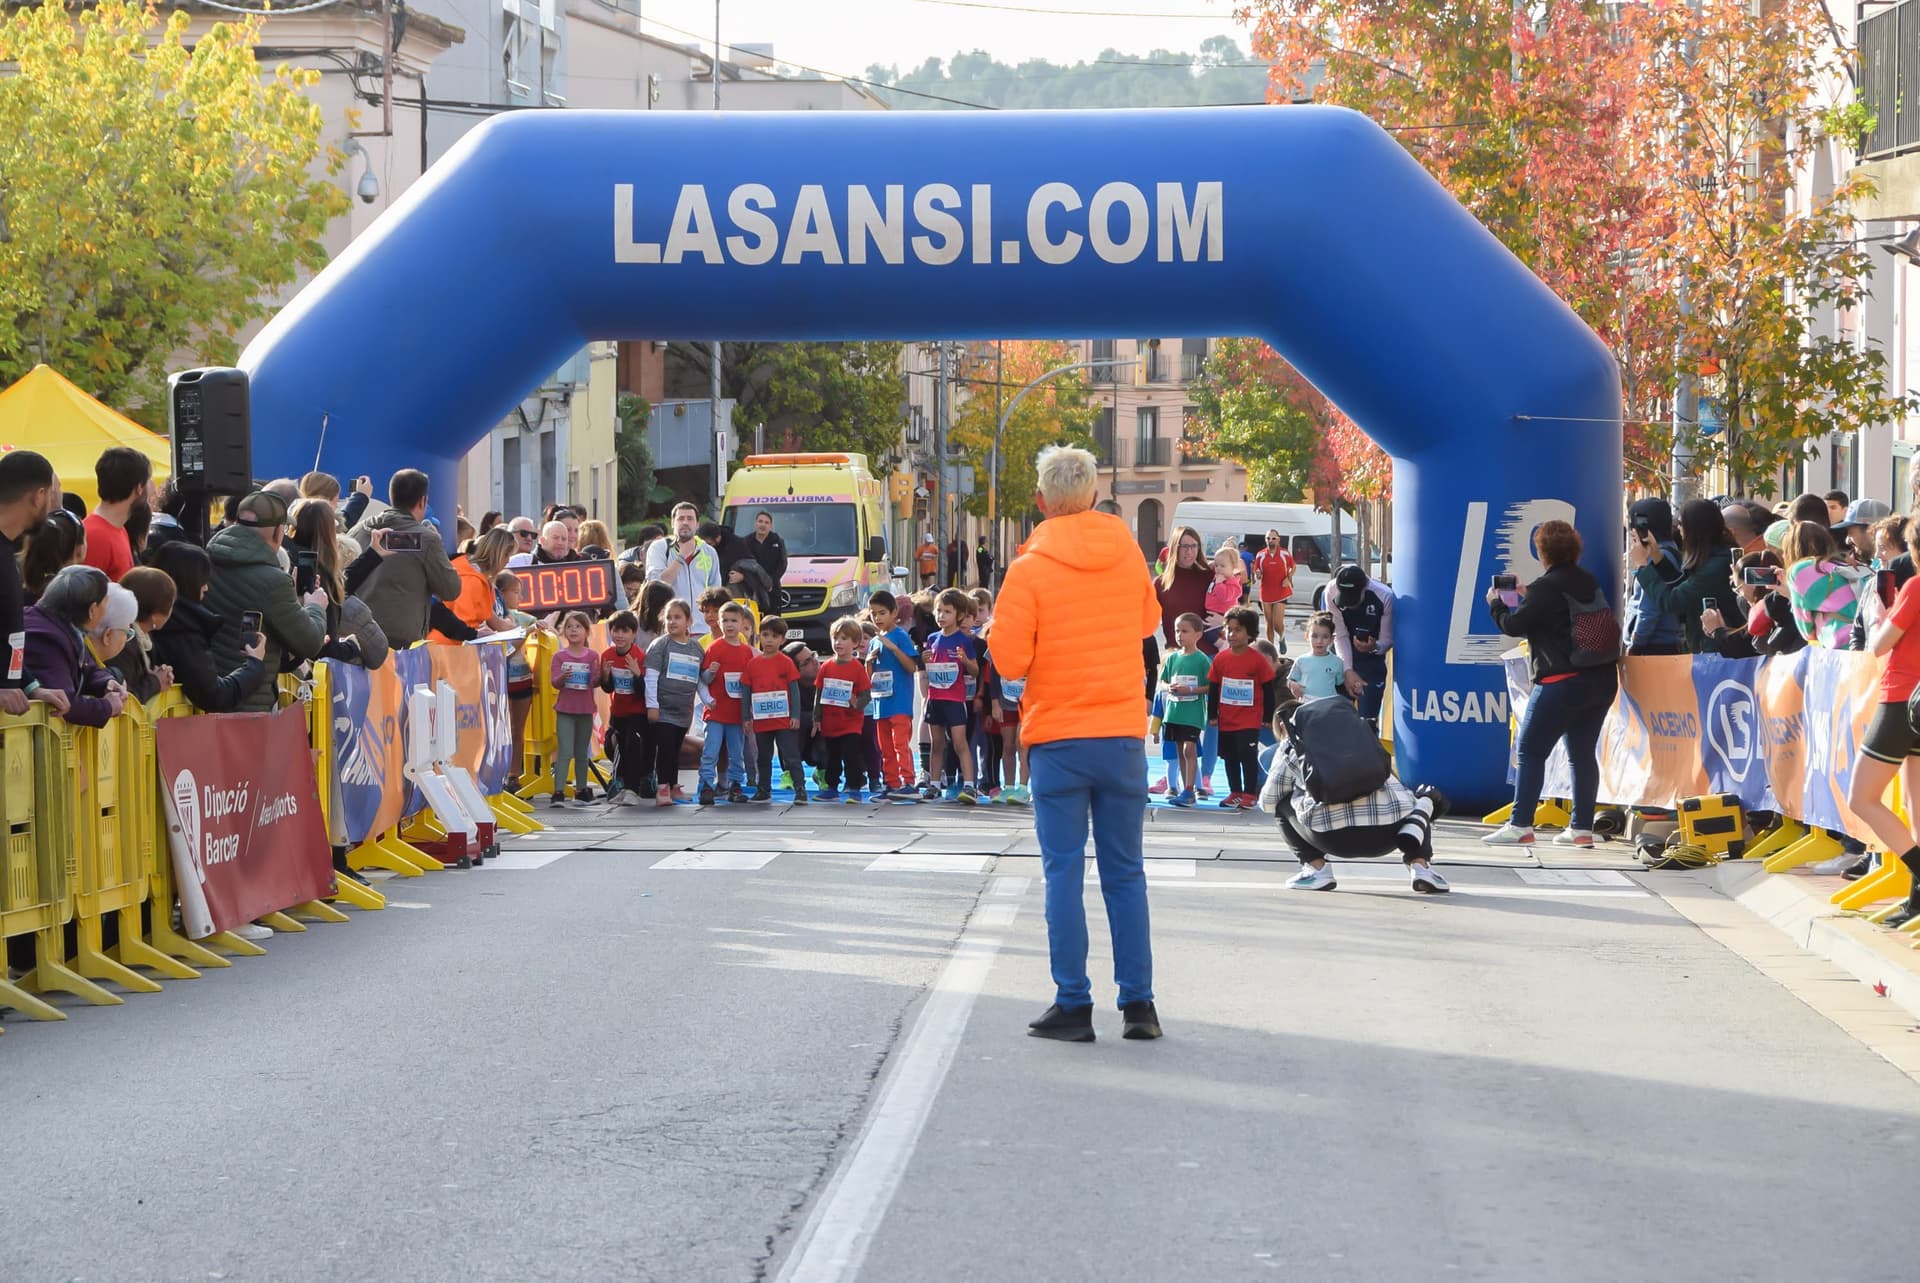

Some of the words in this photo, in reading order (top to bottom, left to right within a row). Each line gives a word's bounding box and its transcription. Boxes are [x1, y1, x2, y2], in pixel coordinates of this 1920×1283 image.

[614, 181, 1223, 265] LASANSI.COM
[934, 672, 953, 682] NIL
[760, 700, 784, 711] ERIC
[1411, 688, 1508, 724] LASAN
